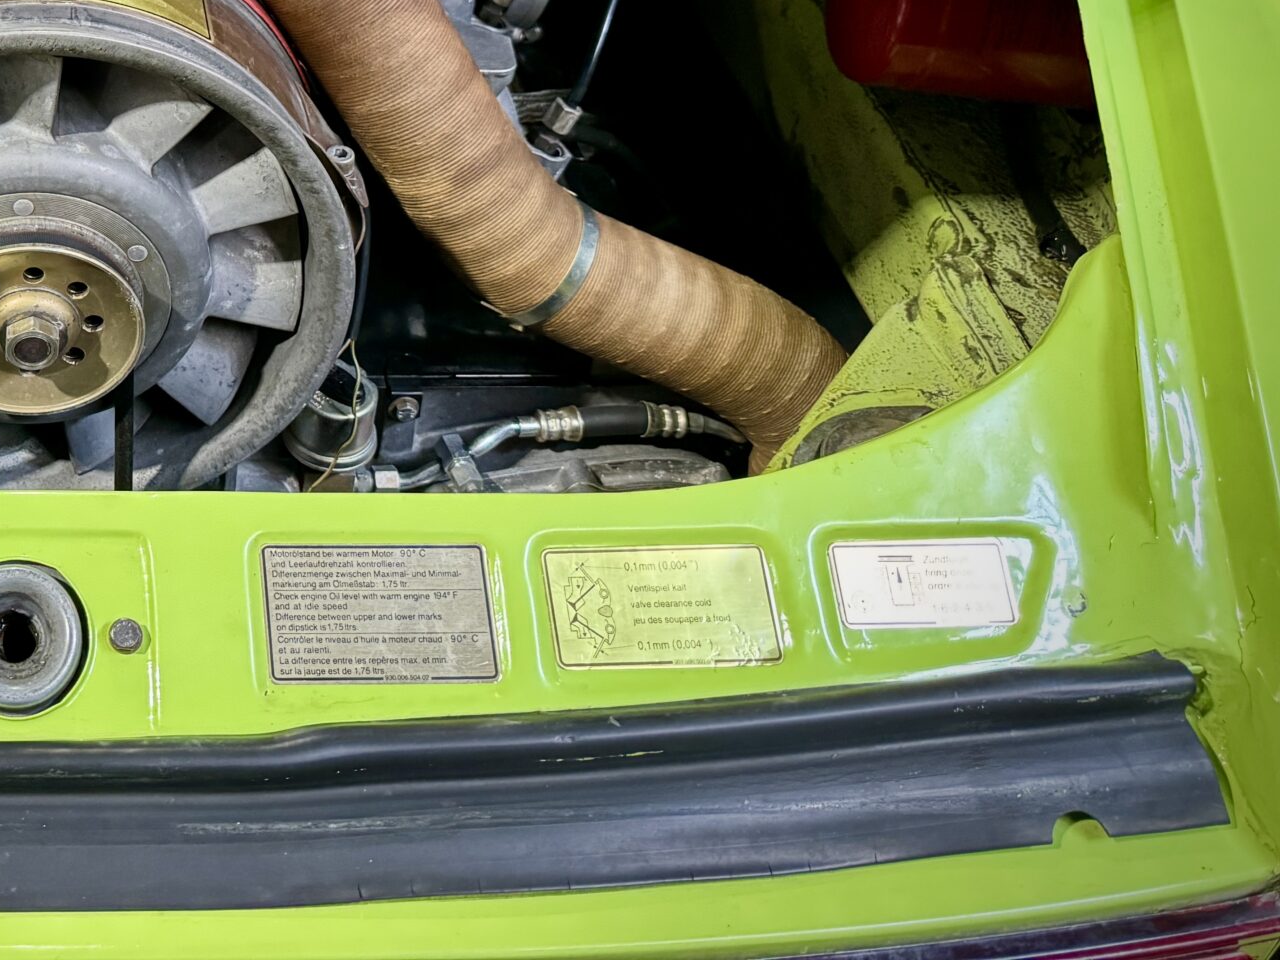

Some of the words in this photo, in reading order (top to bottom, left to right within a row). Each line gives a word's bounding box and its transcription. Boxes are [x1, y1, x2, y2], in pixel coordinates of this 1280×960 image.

[419, 549, 426, 557] C
[272, 570, 333, 579] Differenzmenge
[273, 581, 316, 590] markierung
[383, 580, 398, 588] 1,75
[627, 584, 669, 593] Ventilspiel
[274, 592, 298, 600] Check
[404, 593, 430, 602] engine
[453, 591, 458, 599] F
[305, 602, 319, 610] idle
[323, 603, 348, 611] speed
[633, 617, 645, 626] jeu
[648, 616, 662, 624] des
[288, 623, 317, 631] dipstick
[328, 623, 344, 631] 1,75
[278, 635, 313, 643] Contrôler
[472, 634, 478, 642] C
[295, 667, 302, 675] la
[304, 667, 325, 676] jauge
[342, 667, 351, 675] de
[355, 667, 370, 675] 1,75
